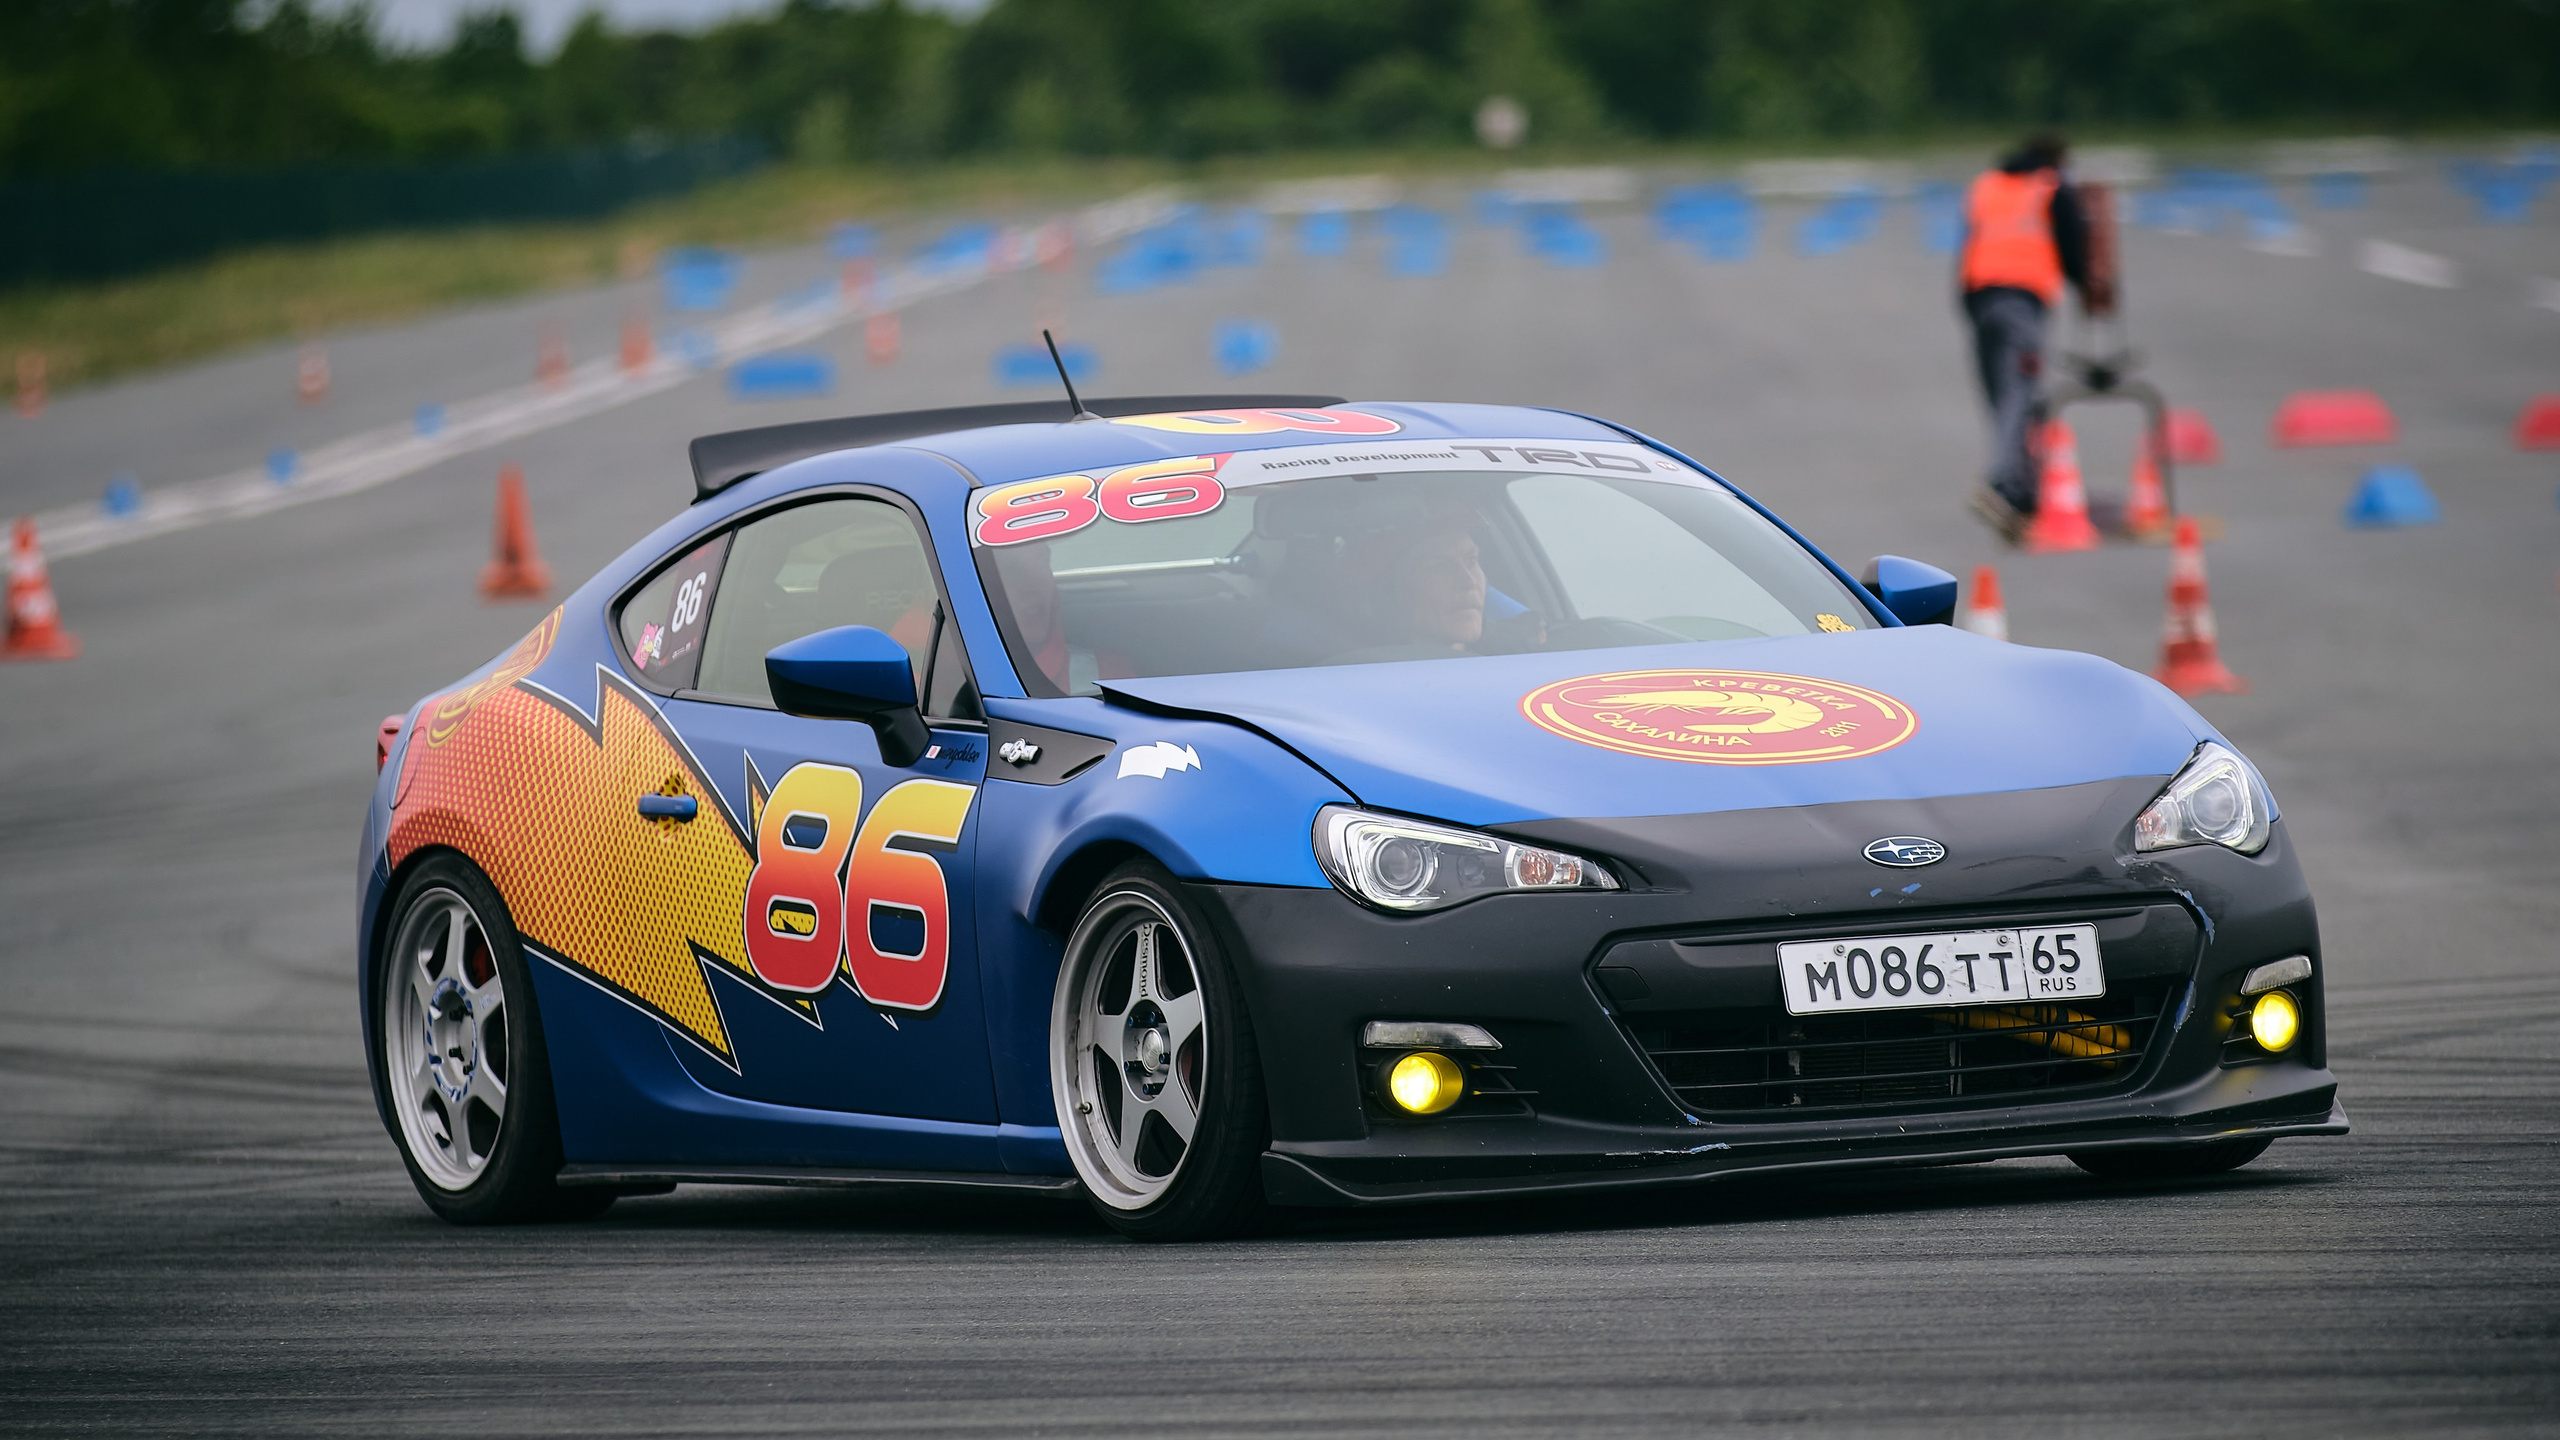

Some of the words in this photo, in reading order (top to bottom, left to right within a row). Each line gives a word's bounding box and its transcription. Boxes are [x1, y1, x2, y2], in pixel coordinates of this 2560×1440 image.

[1260, 457, 1331, 470] Racing
[1334, 452, 1460, 464] Development
[1449, 445, 1652, 473] TRD
[976, 454, 1225, 547] 86
[671, 571, 707, 633] 86
[1692, 678, 1857, 711] КРЕВЕТКА
[1592, 711, 1752, 746] САХАЛИНА
[1819, 720, 1862, 738] 2011
[744, 761, 978, 1012] 86
[1140, 923, 1152, 999] Desmond
[2032, 934, 2081, 975] 65
[2039, 976, 2077, 992] RUS
